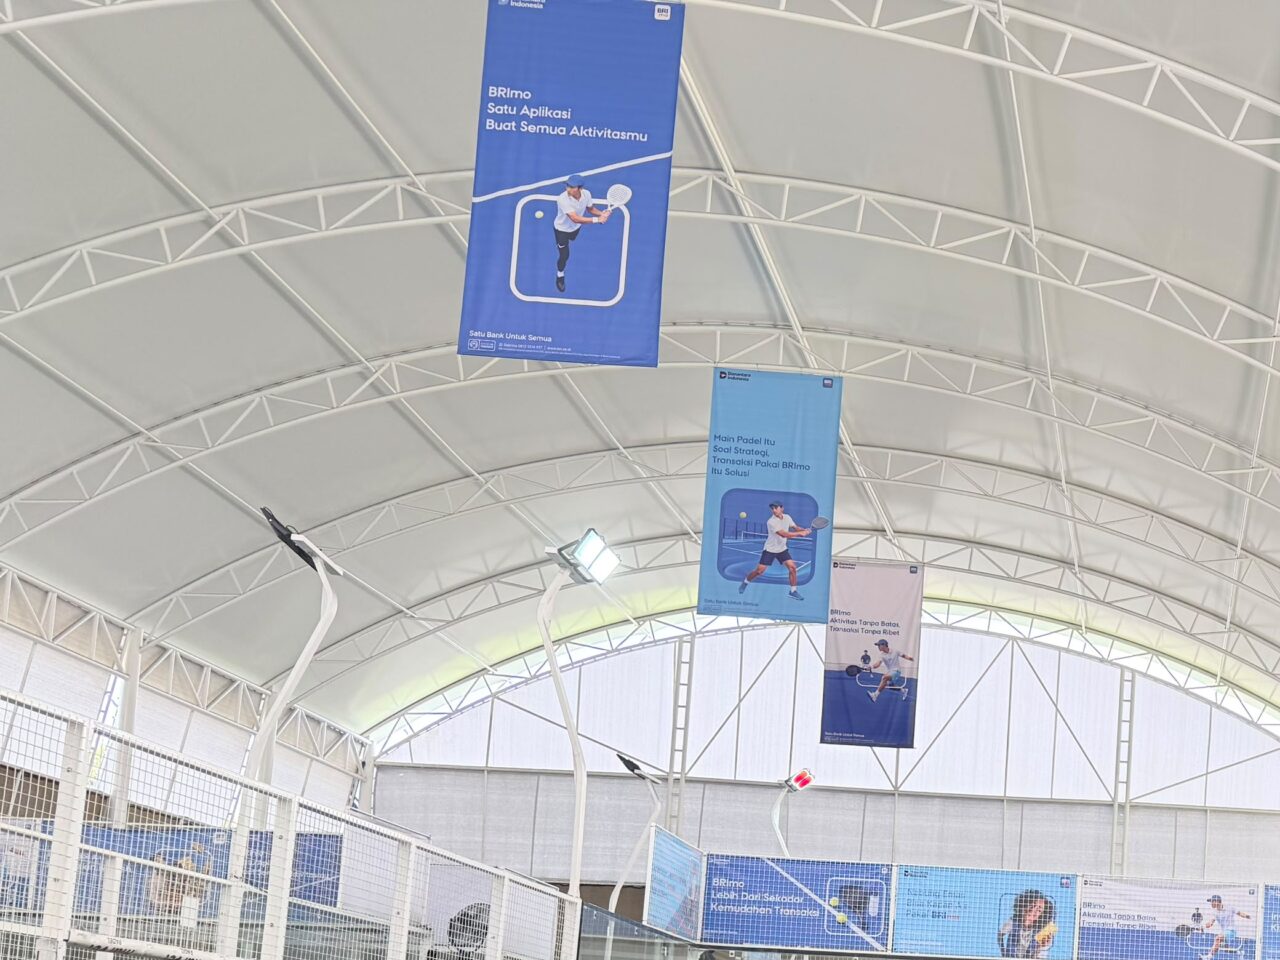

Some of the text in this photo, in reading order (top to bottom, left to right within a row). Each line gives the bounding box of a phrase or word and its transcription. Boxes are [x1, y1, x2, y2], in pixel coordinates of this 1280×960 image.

[510, 1, 543, 9] Indonesia
[488, 86, 531, 99] BRImo
[487, 103, 571, 119] Satu Aplikasi
[486, 119, 648, 141] Buat Semua Aktivitasmu
[469, 330, 552, 342] Satu Bank Untuk Semua
[713, 434, 775, 446] Main Padel Itu
[713, 445, 769, 457] Soal Strategi,
[712, 456, 810, 471] Transaksi Pakai BRImo
[711, 467, 749, 477] Itu Solusi
[830, 617, 879, 628] Aktivitas Tanpa
[830, 626, 859, 634] Transaksi
[861, 628, 881, 636] Tanpa
[711, 890, 738, 900] Lebih
[741, 892, 761, 901] Dari
[711, 902, 819, 917] Kemudahan Transaksi
